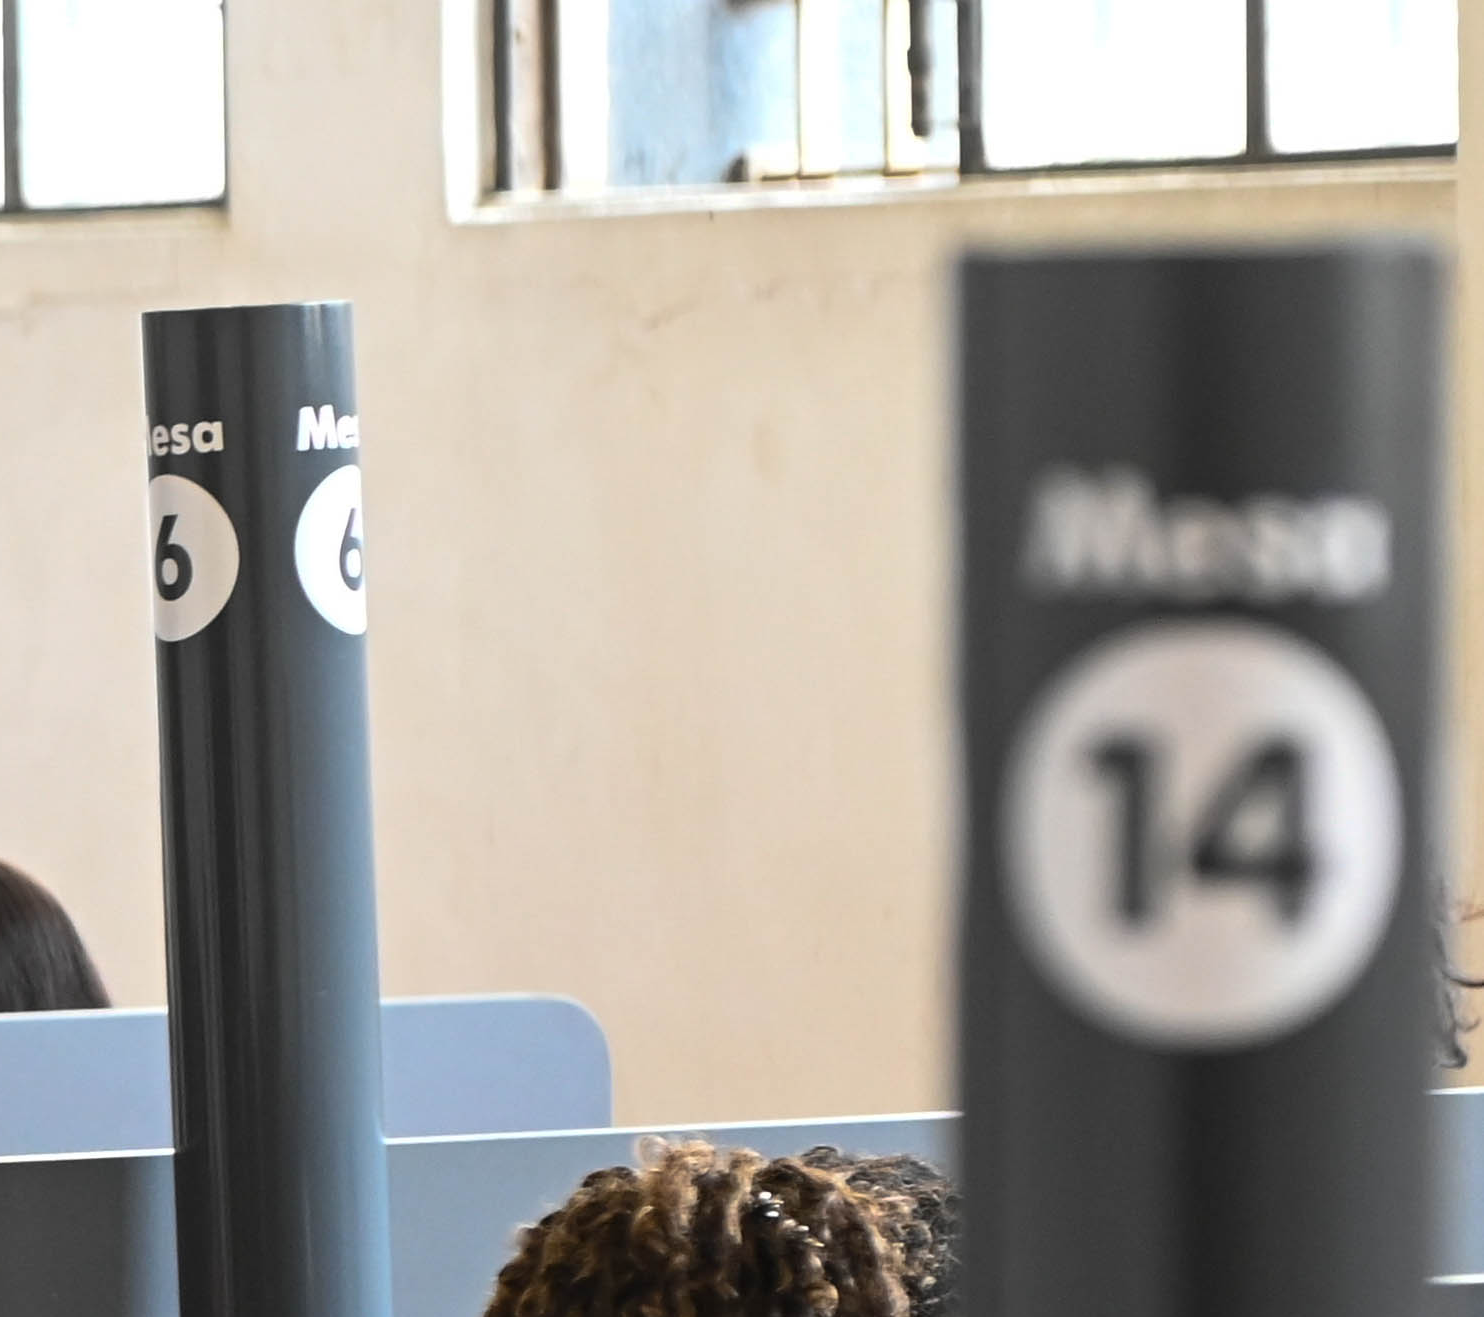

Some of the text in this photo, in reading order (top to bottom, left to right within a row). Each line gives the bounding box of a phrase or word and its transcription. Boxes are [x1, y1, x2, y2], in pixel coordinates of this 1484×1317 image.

[147, 416, 225, 456] esa
[297, 403, 360, 452] Me
[154, 513, 194, 603] 6
[339, 506, 363, 592] 6
[1026, 468, 1391, 600] Mesa
[1082, 733, 1320, 934] 14
